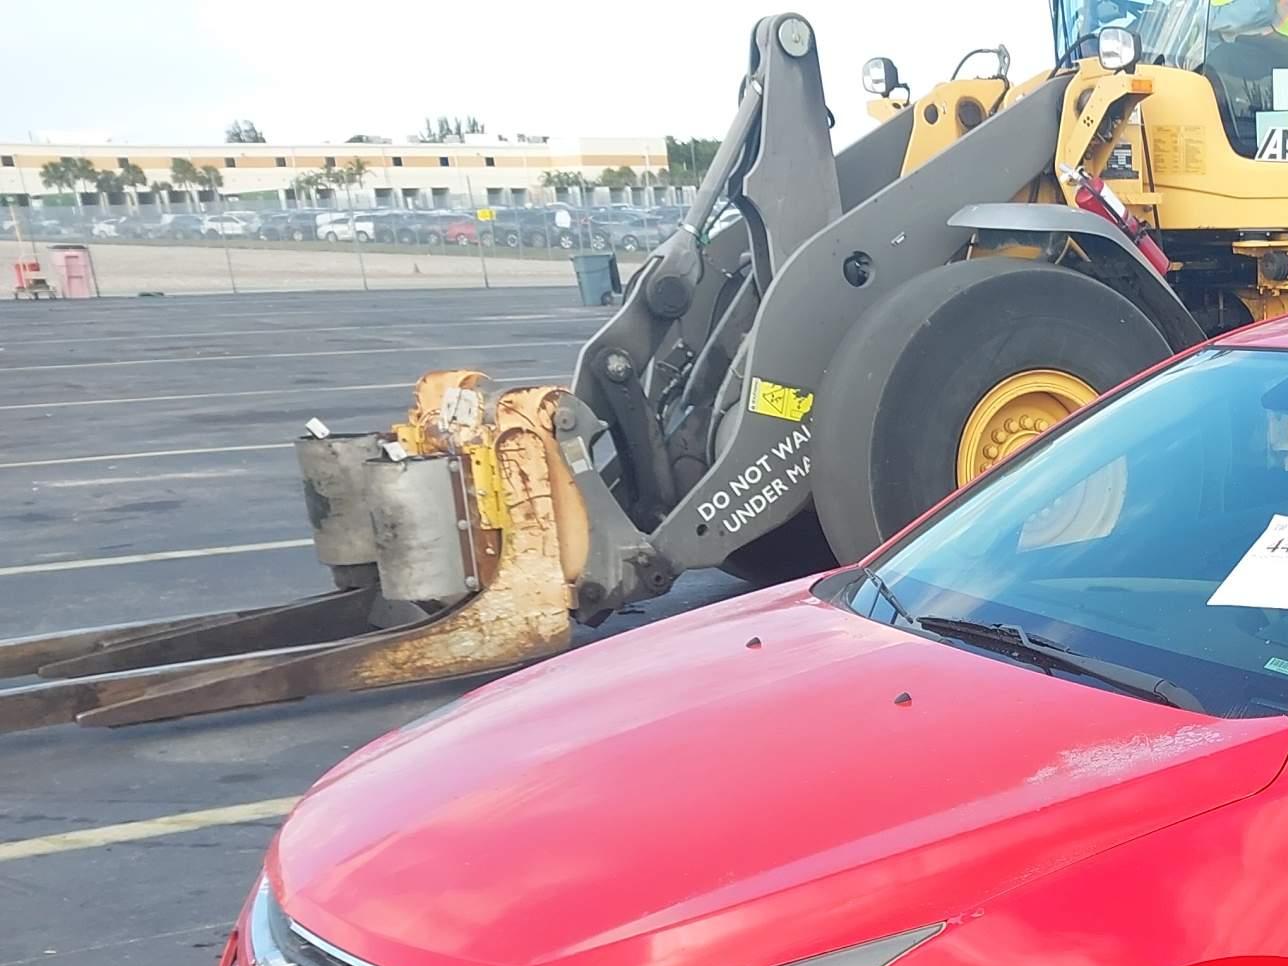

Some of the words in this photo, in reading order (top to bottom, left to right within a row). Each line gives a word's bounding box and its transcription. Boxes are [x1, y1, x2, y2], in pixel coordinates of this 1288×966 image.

[697, 491, 730, 521] DO
[729, 455, 772, 496] NOT
[723, 478, 789, 532] UNDER
